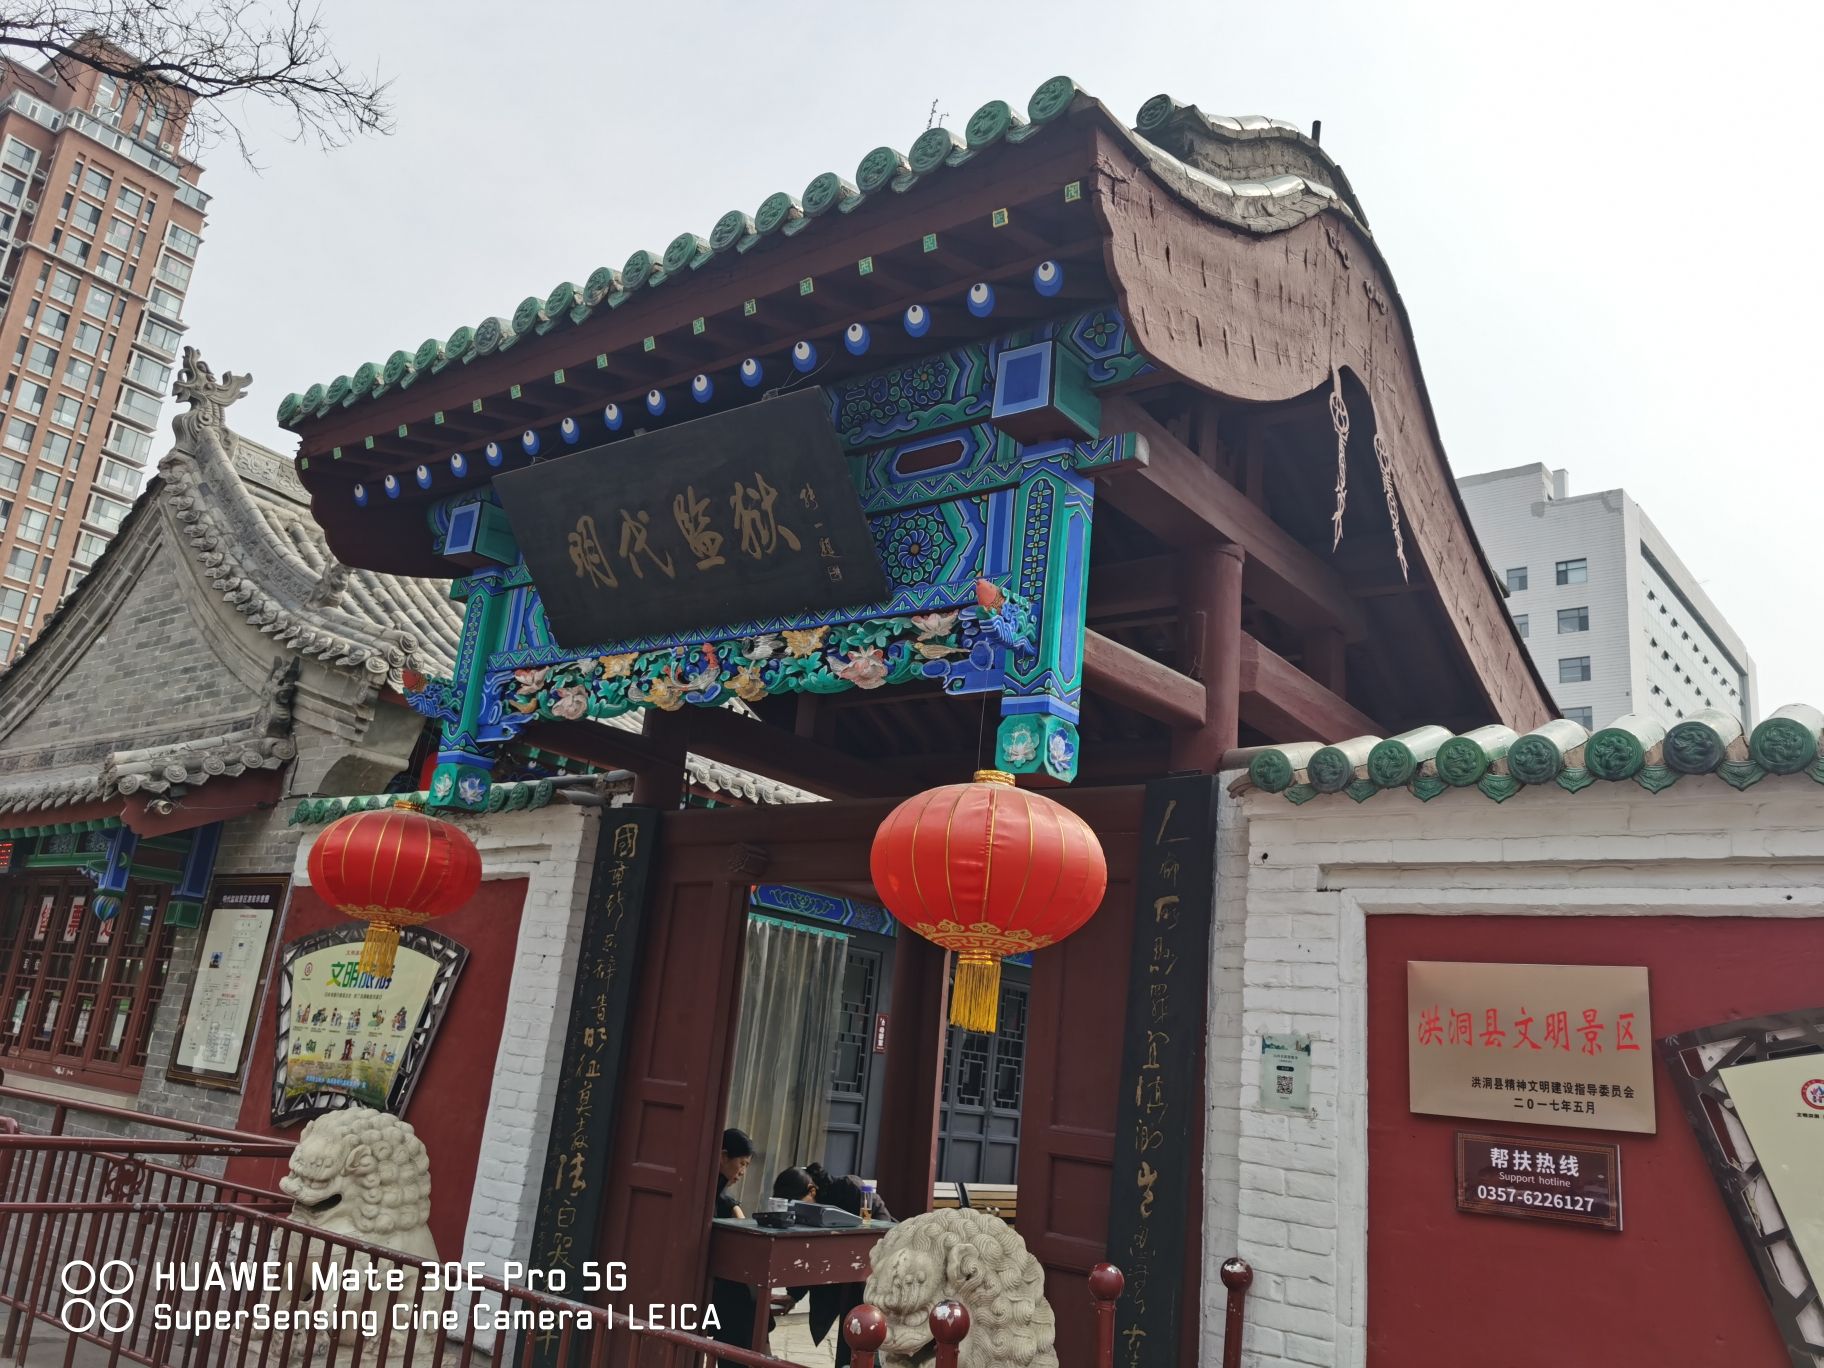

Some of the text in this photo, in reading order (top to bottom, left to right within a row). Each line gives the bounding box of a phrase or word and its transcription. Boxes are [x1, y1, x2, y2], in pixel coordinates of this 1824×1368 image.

[1417, 1004, 1641, 1056] 洪洞县文明景区
[1471, 1076, 1635, 1099] 洪洞县精神文明建设指导委员会
[1490, 1147, 1580, 1177] 帮扶热线
[1499, 1171, 1571, 1188] Support hotline
[1477, 1184, 1595, 1212] 0357-6226127
